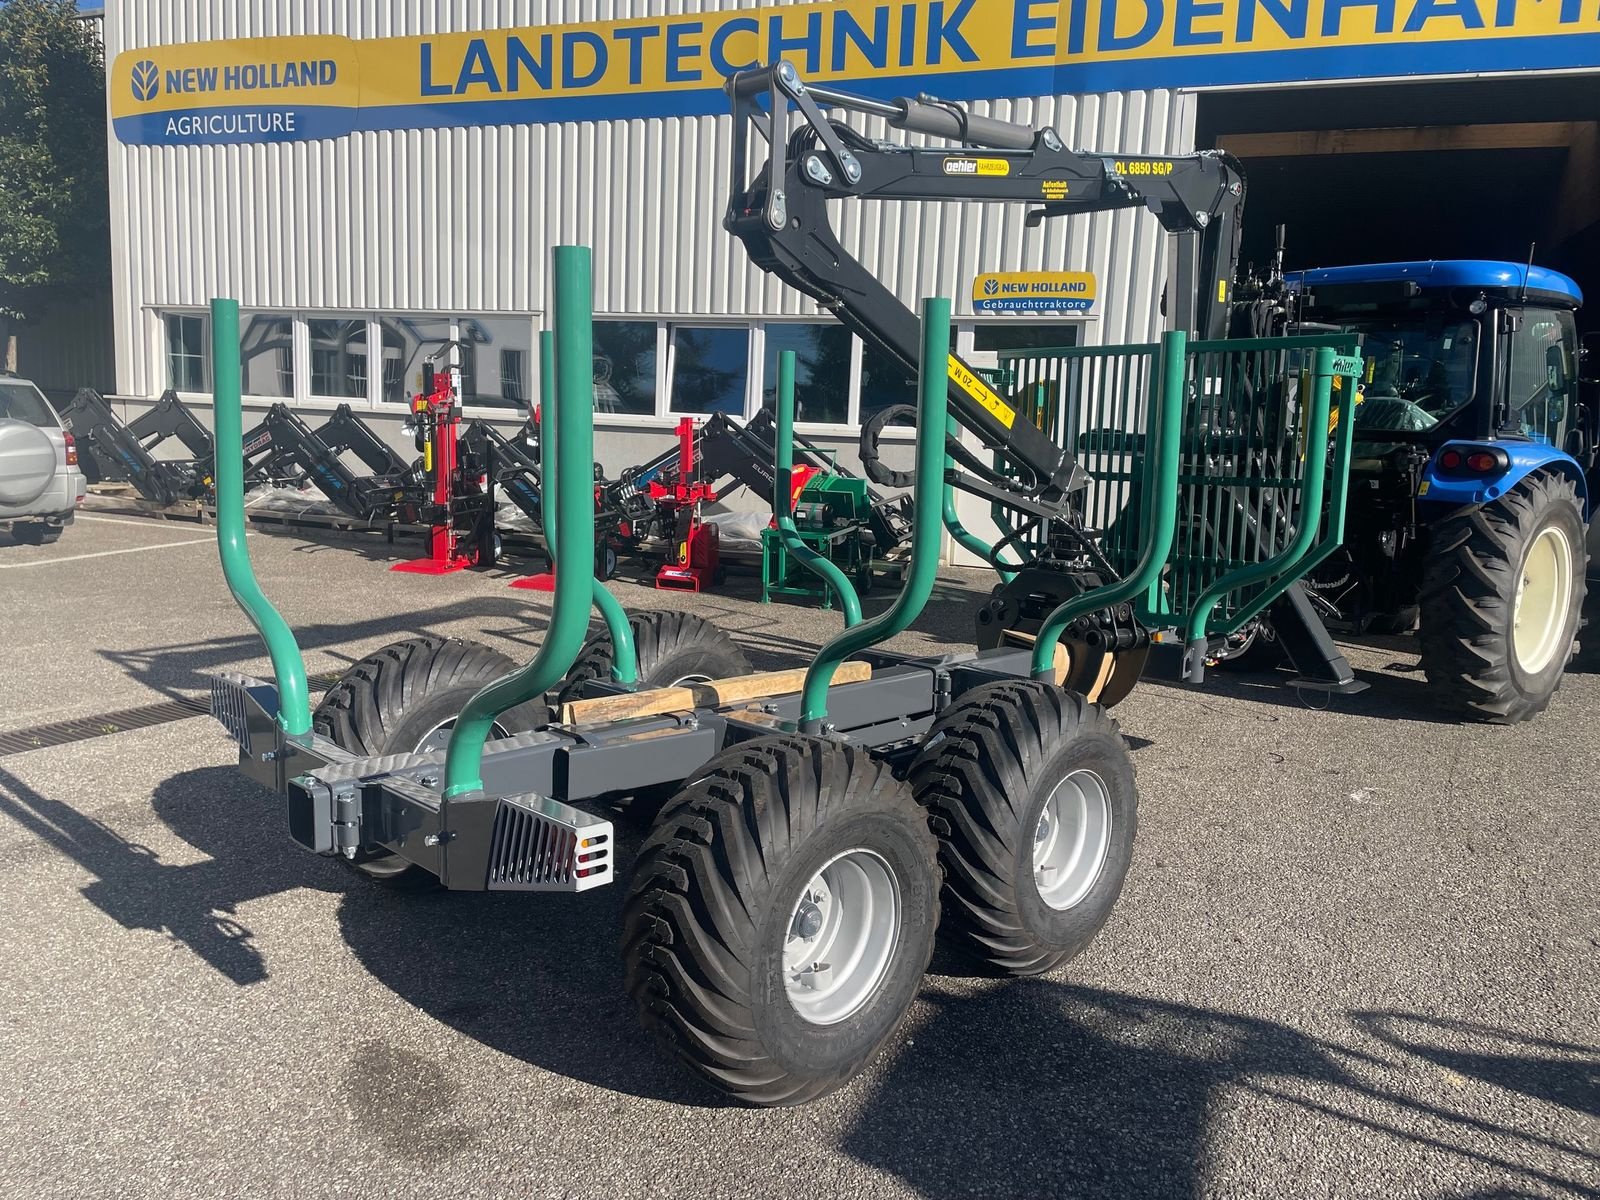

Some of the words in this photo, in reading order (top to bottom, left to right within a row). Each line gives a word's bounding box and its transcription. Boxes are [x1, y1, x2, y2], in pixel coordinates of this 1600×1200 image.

[419, 0, 980, 96] LANDTECHNIK
[1010, 0, 1600, 59] EIDENH
[166, 67, 218, 94] NEW
[224, 60, 337, 91] HOLLAND
[165, 112, 295, 136] AGRICULTURE
[946, 160, 977, 173] oehler
[1115, 161, 1128, 175] OL
[1129, 162, 1151, 175] 6850
[1152, 162, 1173, 176] SG/P
[1002, 283, 1029, 293] NEW
[1031, 282, 1087, 293] HOLLAND
[982, 299, 1086, 309] Gebrauchttraktore
